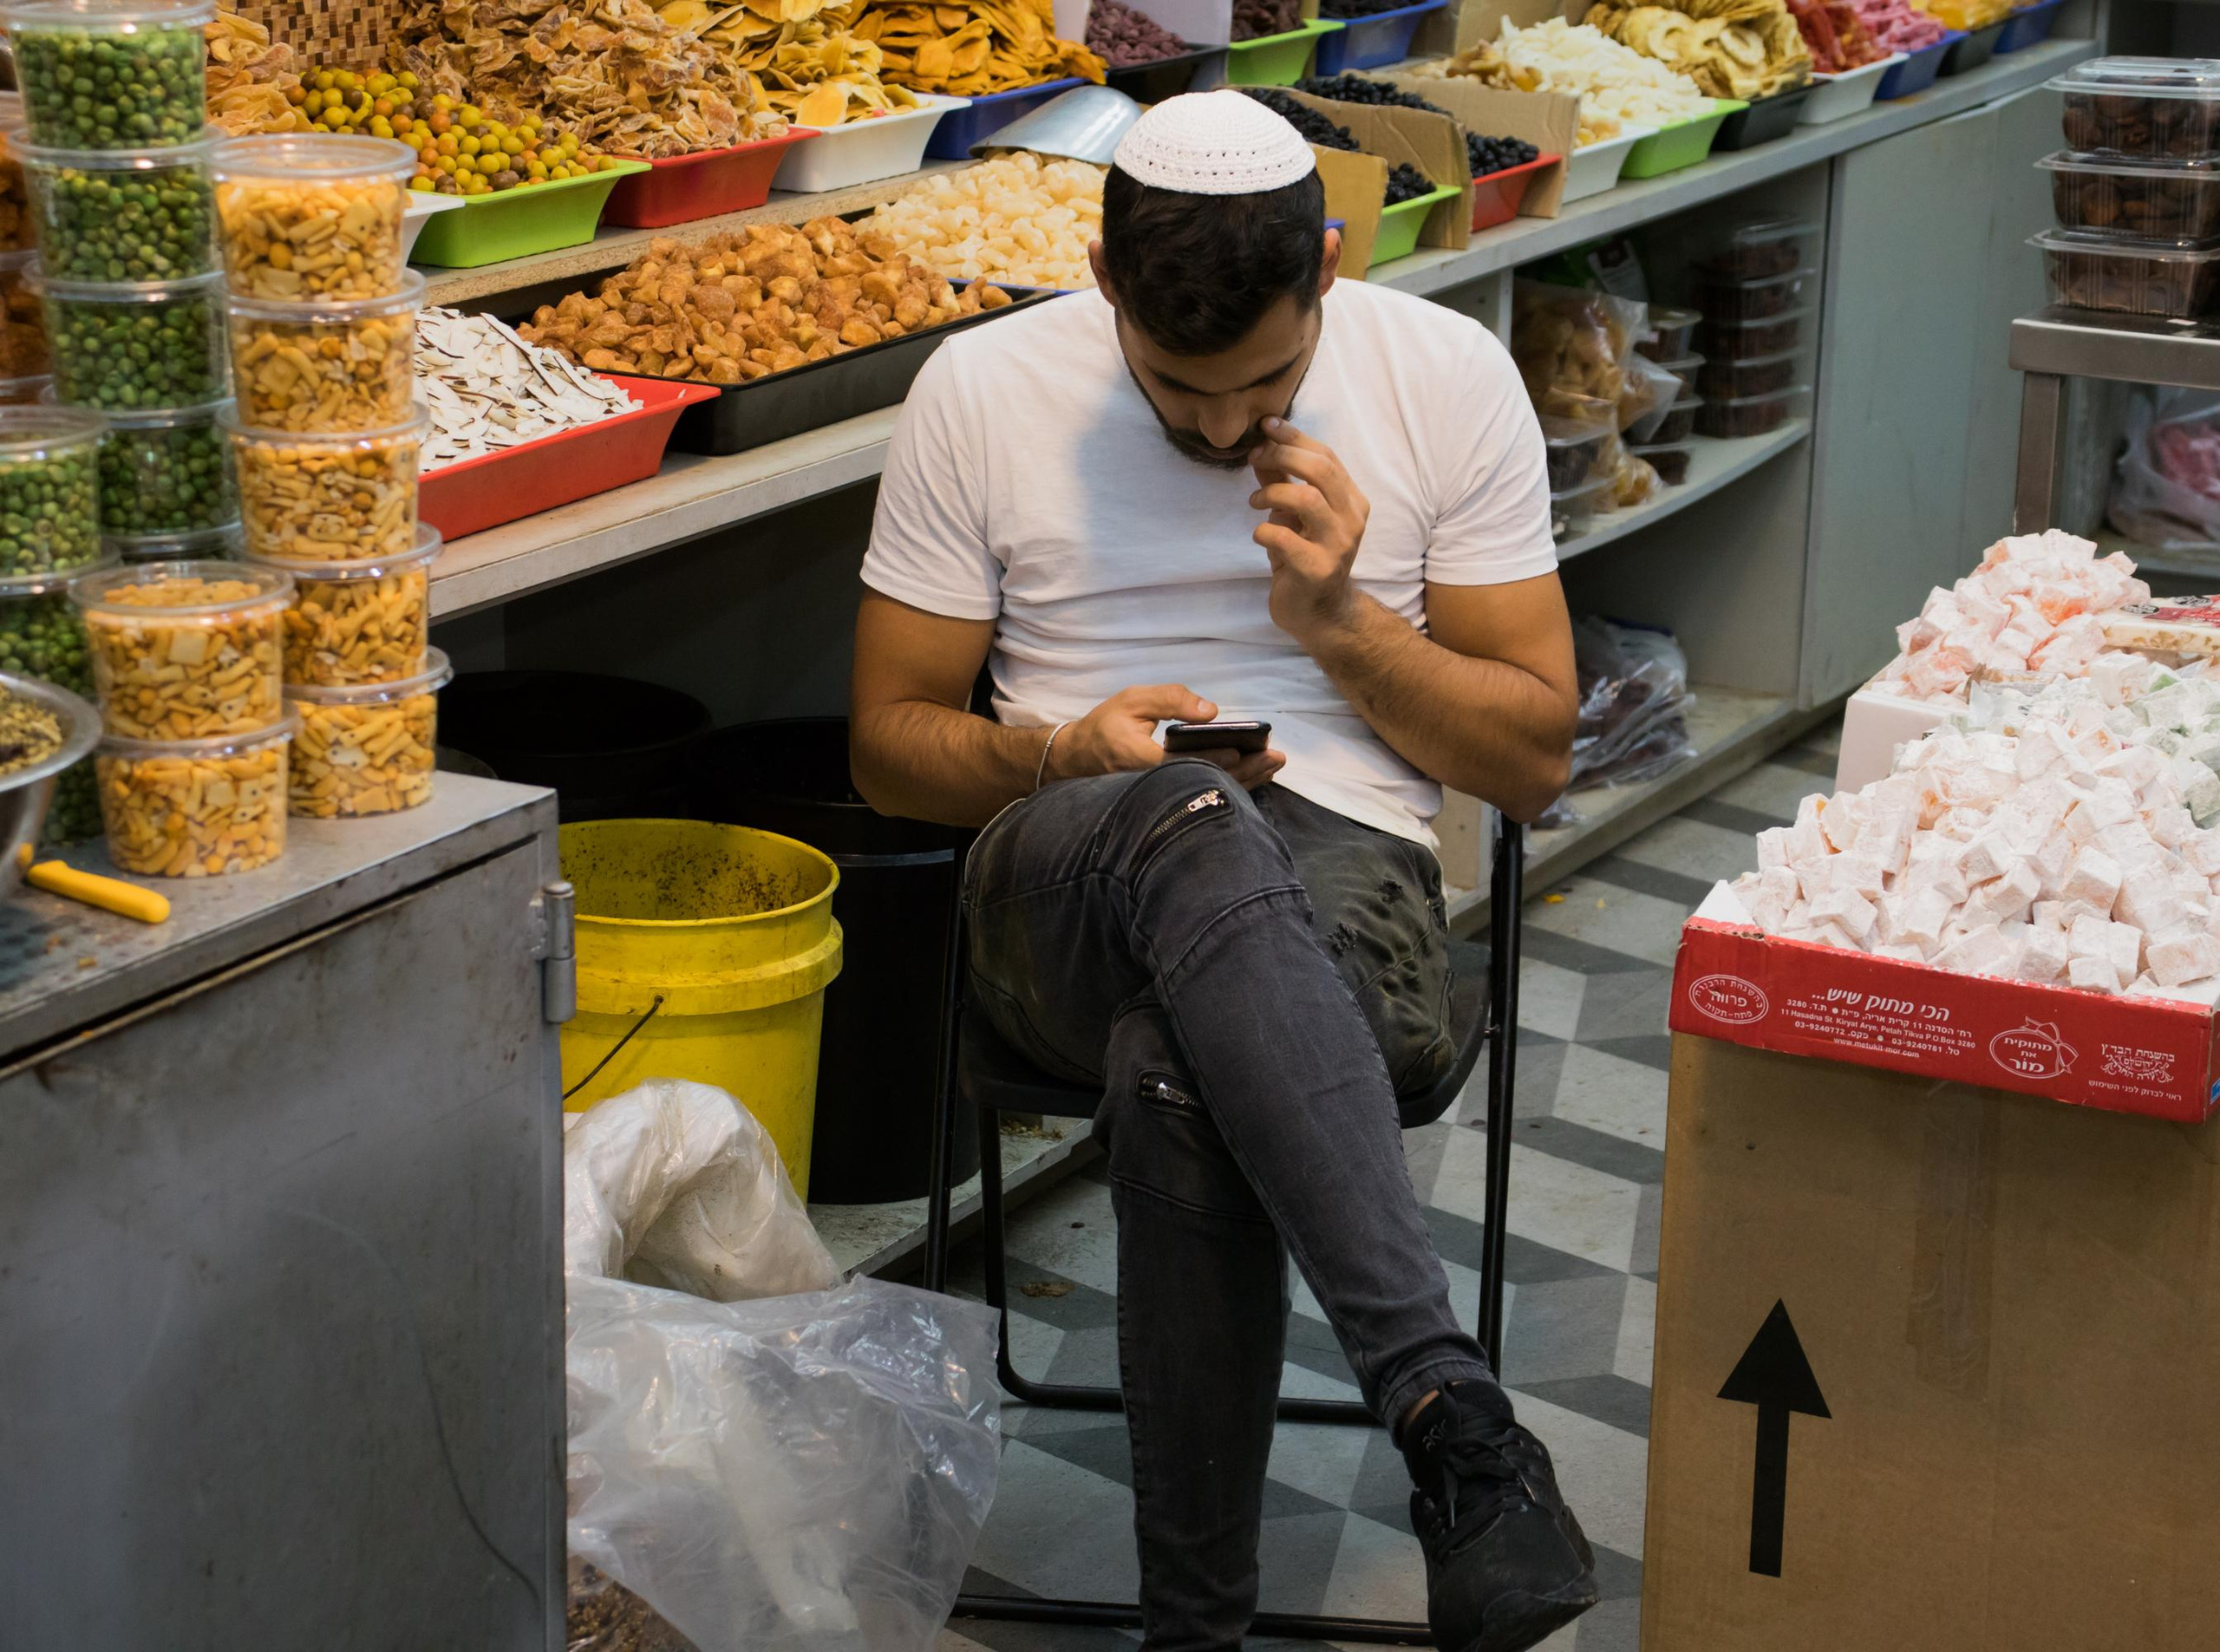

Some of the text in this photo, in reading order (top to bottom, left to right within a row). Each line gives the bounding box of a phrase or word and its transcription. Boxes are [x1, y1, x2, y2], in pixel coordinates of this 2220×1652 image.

[1786, 998, 1807, 1008] 3280
[1864, 995, 1915, 1015] מתוק
[1920, 1004, 1949, 1022] הכי
[1791, 1009, 1823, 1022] Hasadna
[1836, 1017, 1858, 1028] Kiryat
[1881, 1025, 1903, 1035] Petah
[1904, 1029, 1924, 1039] Tikva
[1957, 1040, 1976, 1049] 3280
[1794, 1021, 1845, 1035] 03-9240772
[1888, 1016, 1910, 1028] קרית
[1925, 1023, 1955, 1035] הסדנה
[1833, 1037, 1920, 1058] www.metukit-mor.com
[1891, 1037, 1942, 1052] 03-9240781
[2004, 1037, 2053, 1051] מתוקית
[2135, 1048, 2175, 1062] בהשגחת
[2088, 1080, 2182, 1101] ראוי לבדוק לפני השימוש
